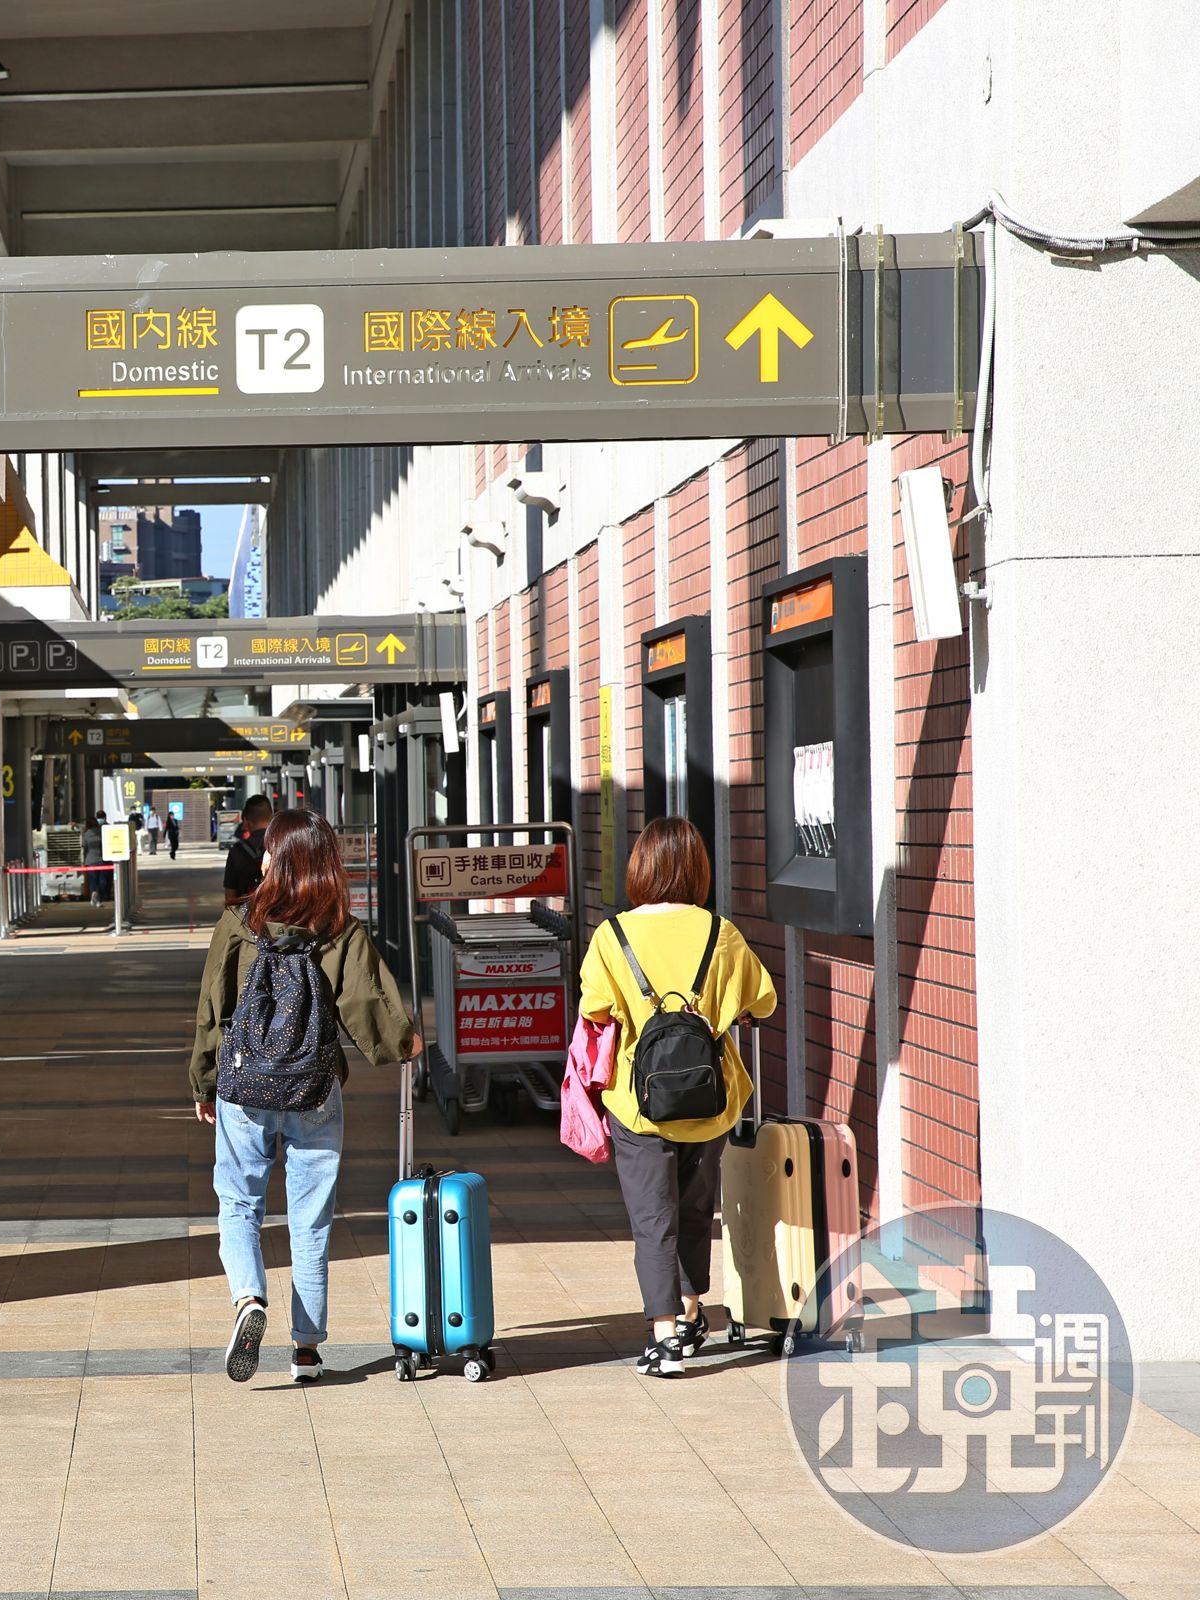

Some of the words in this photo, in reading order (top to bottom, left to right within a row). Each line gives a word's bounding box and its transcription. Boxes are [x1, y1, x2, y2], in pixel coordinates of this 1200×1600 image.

[86, 307, 218, 350] 國內線
[363, 305, 591, 352] 國際線入境
[245, 328, 312, 370] T2
[112, 360, 219, 382] Domestic
[343, 361, 491, 386] International
[500, 358, 591, 383] Arrivals
[144, 638, 191, 653] 國內線
[200, 643, 224, 660] T2
[251, 637, 331, 654] 國際線入境
[147, 656, 191, 666] Domestic
[234, 655, 293, 667] International
[295, 655, 331, 665] Arrivals
[3, 764, 14, 797] 3
[124, 781, 136, 796] 19
[454, 853, 561, 872] 手推車回收處
[470, 876, 503, 886] Carts
[506, 874, 548, 885] Return
[485, 964, 534, 974] MAXXIS
[458, 992, 557, 1012] MAXXIS
[459, 1016, 533, 1030] 瑪吉斯輪胎
